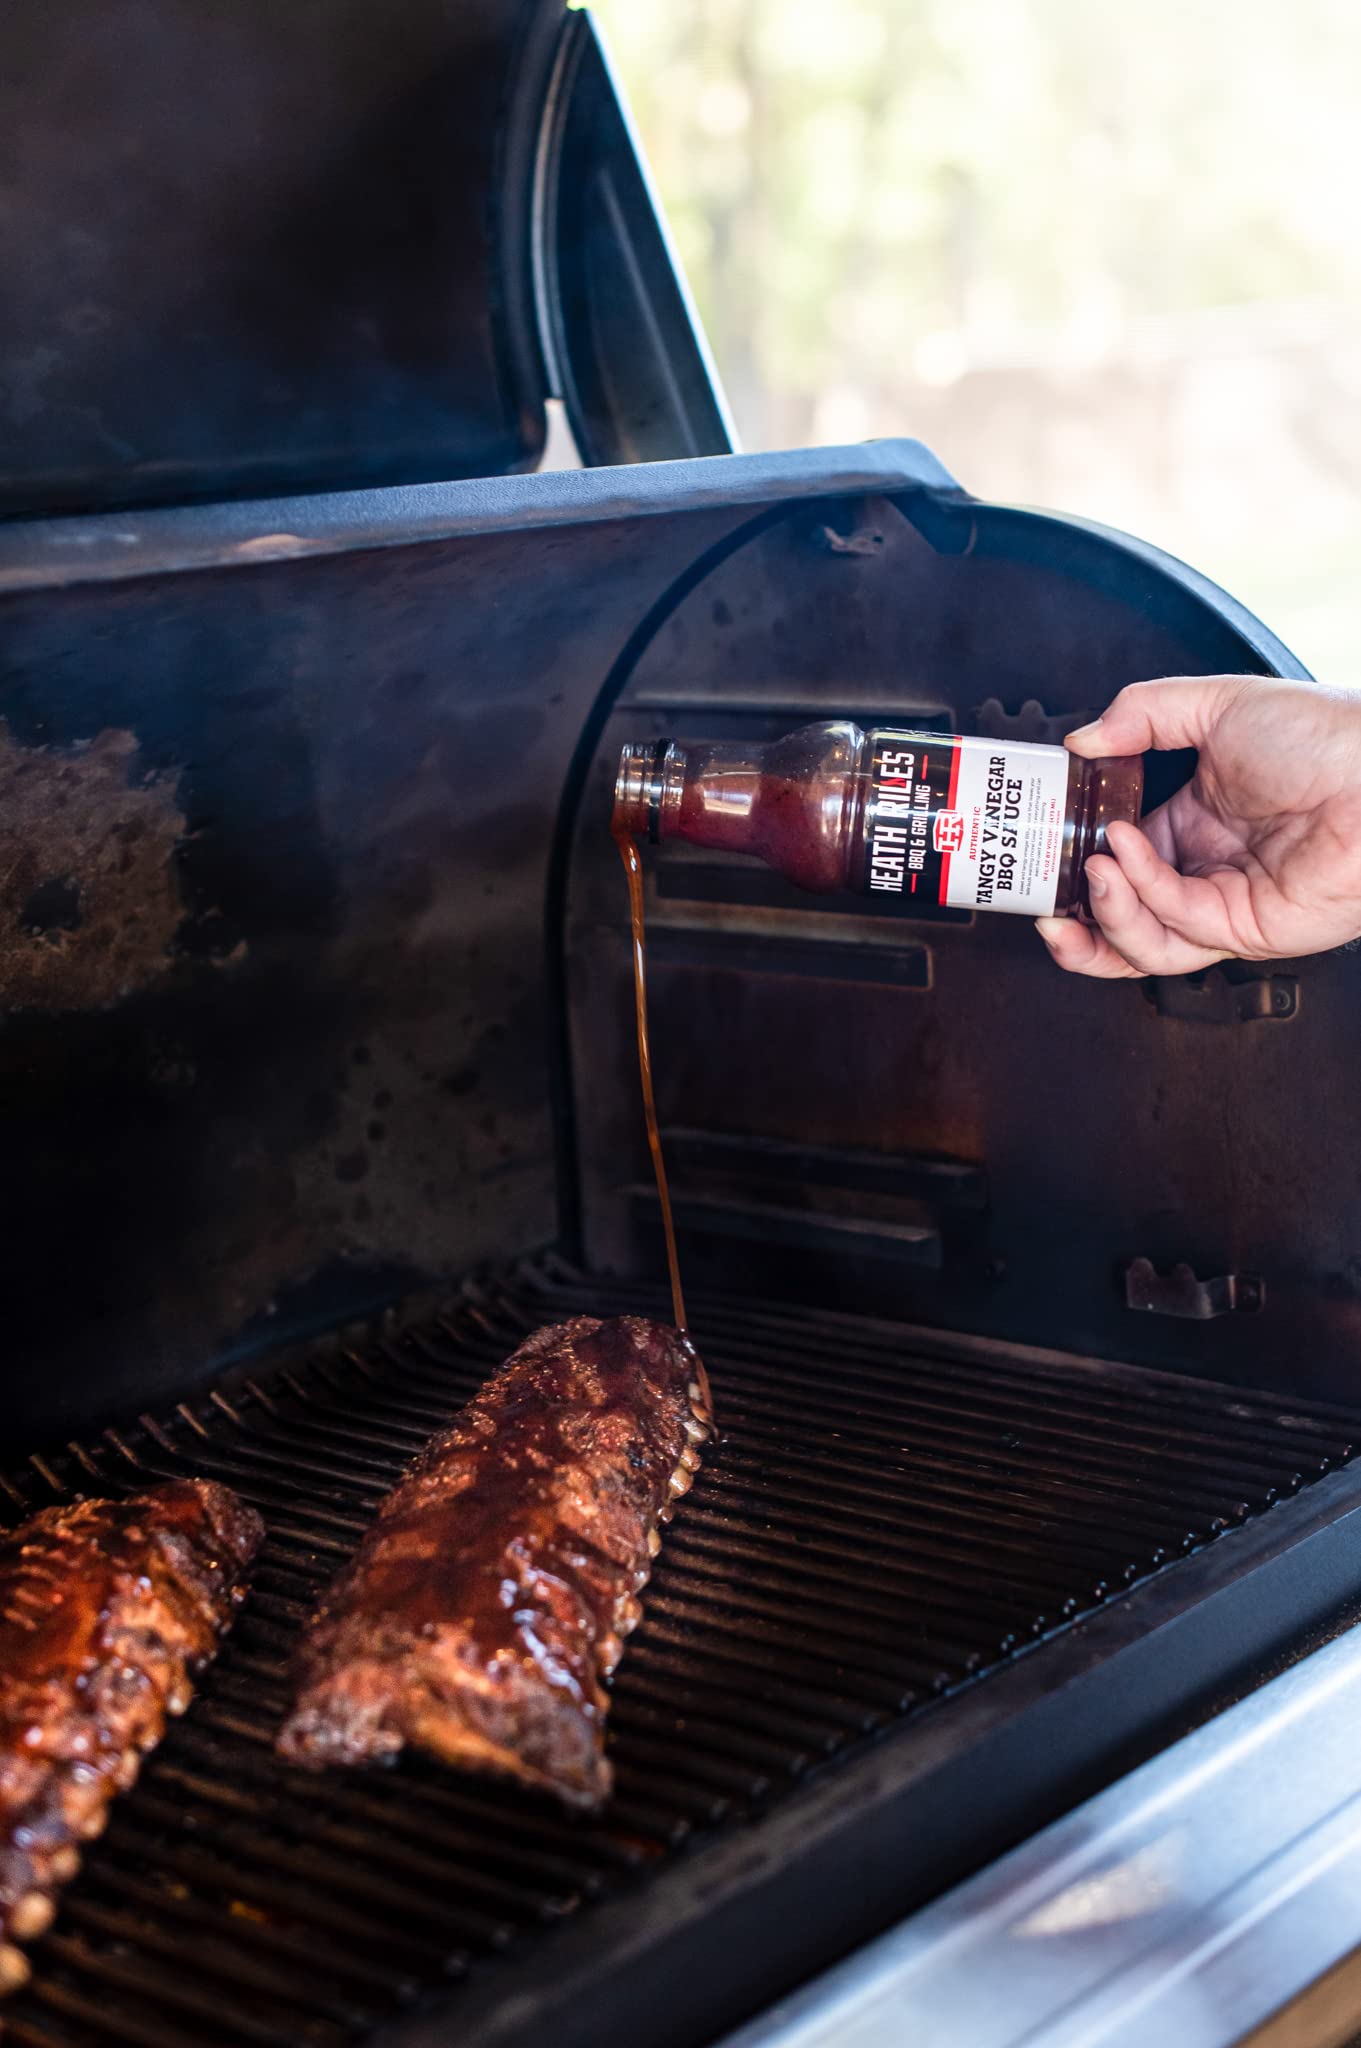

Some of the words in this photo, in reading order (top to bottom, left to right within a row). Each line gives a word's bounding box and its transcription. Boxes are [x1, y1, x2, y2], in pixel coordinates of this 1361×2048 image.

[876, 751, 914, 818] RILES
[912, 784, 931, 835] GRILLING
[983, 756, 1006, 843] VINEGAR
[969, 807, 980, 860] AUTHENTIC
[1002, 779, 1022, 848] SAUCE
[870, 826, 907, 891] HEATH
[908, 849, 924, 870] BBQ
[911, 837, 925, 846] &
[976, 849, 996, 904] TANGY
[997, 853, 1016, 890] BBQ
